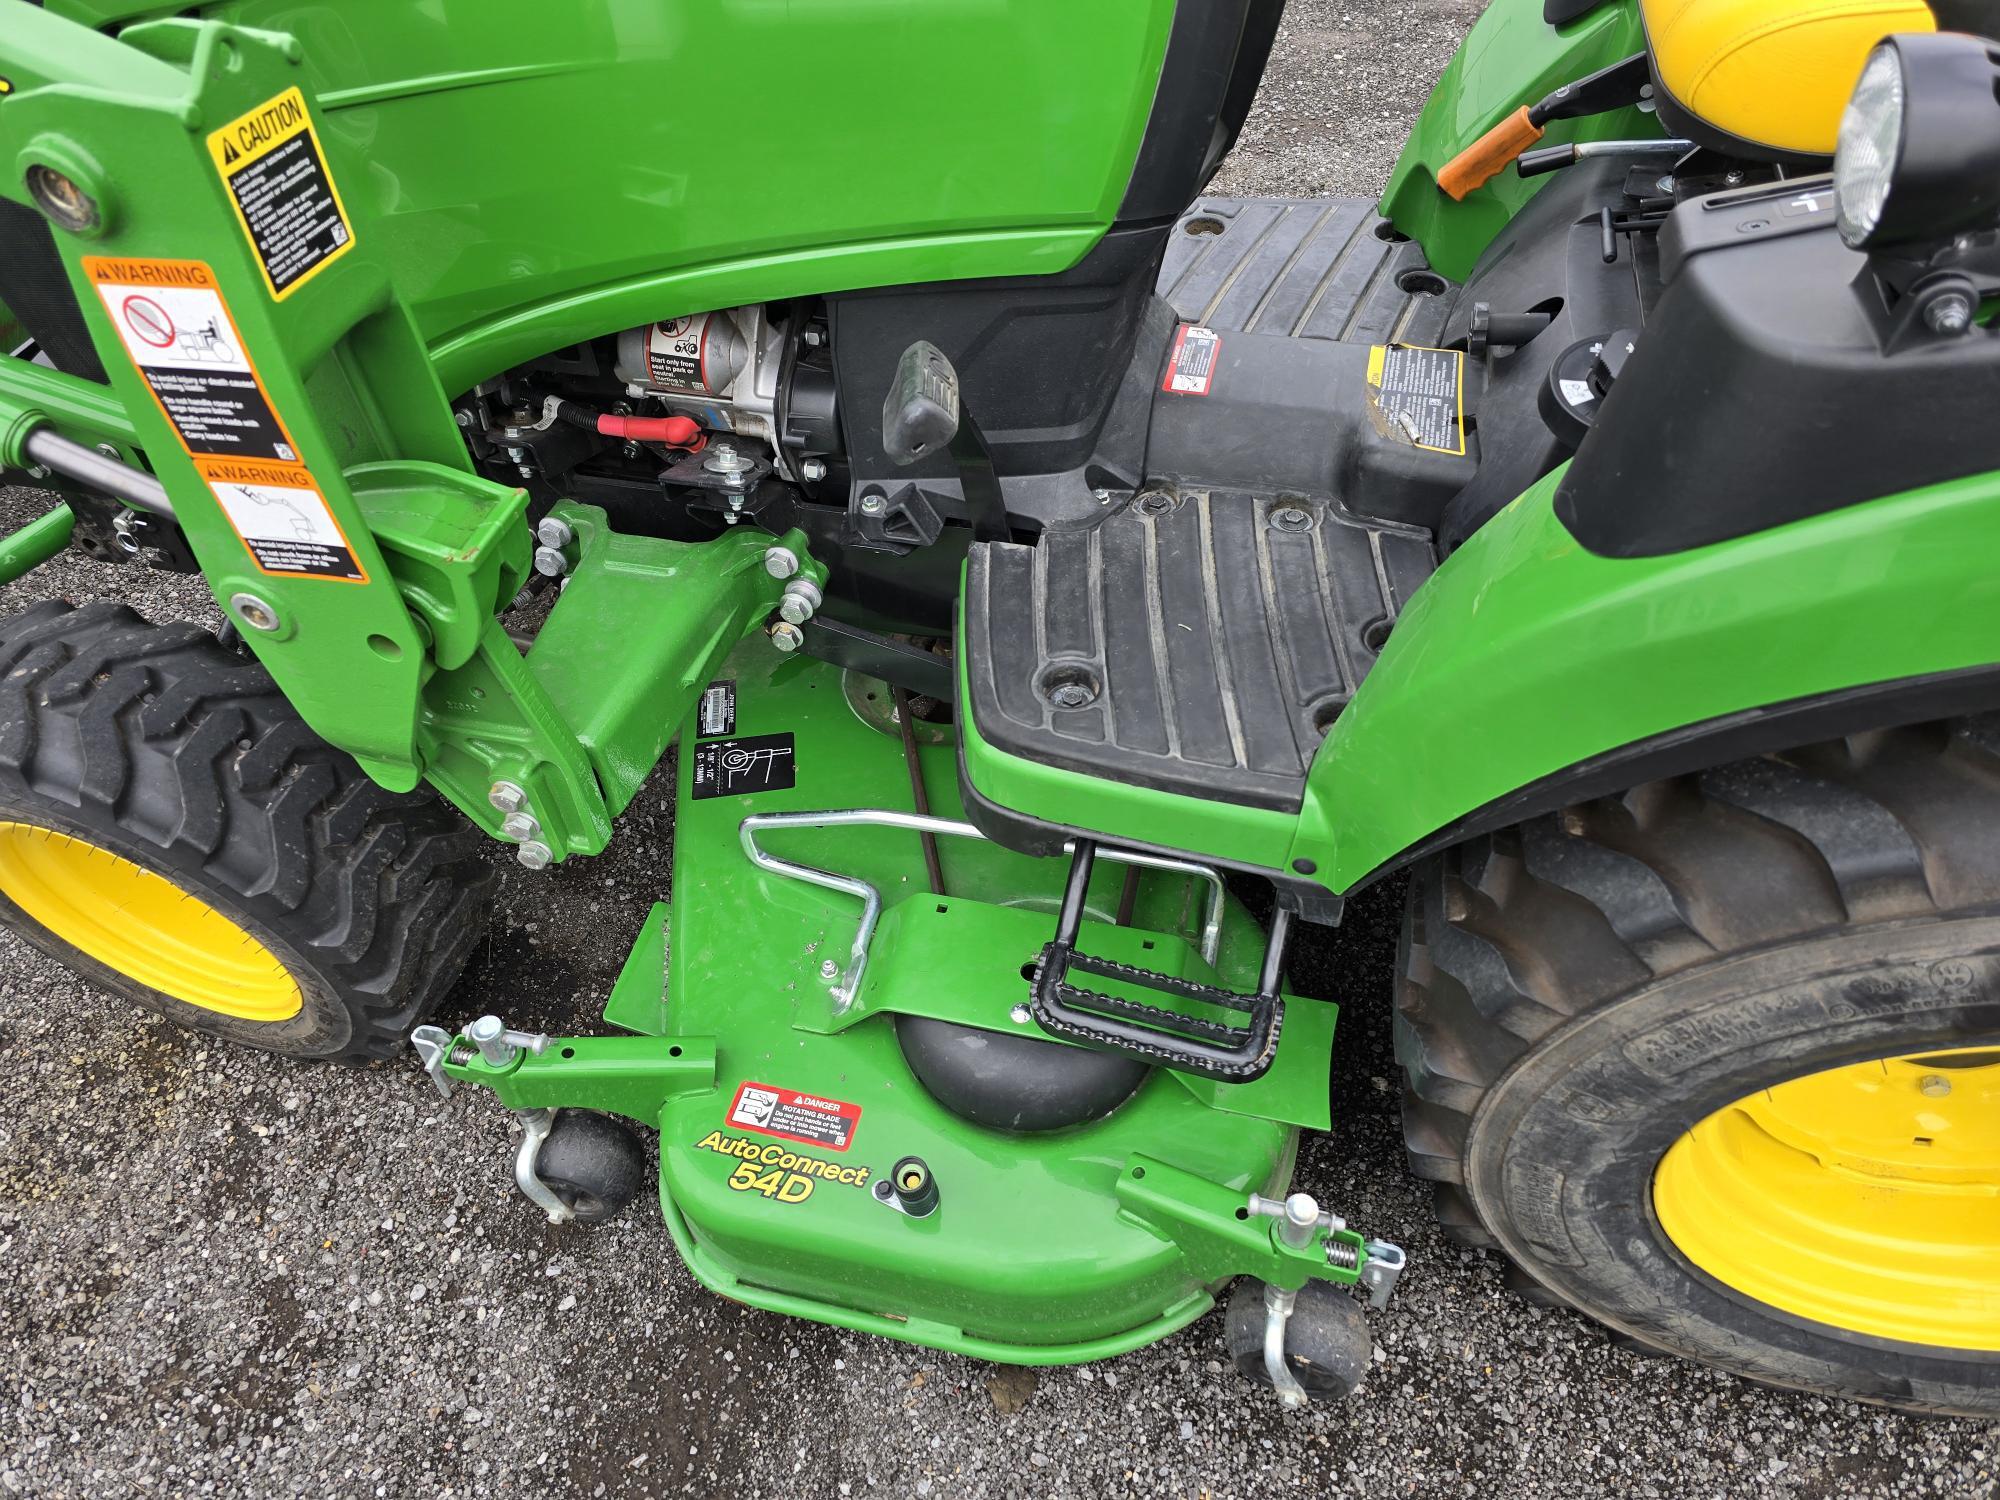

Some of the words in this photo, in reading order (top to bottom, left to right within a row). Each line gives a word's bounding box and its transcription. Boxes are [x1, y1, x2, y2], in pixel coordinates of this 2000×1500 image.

[238, 96, 303, 152] CAUTION
[107, 264, 208, 284] WARNING
[218, 465, 309, 485] WARNING
[782, 1105, 816, 1118] ROTATING
[817, 1113, 840, 1123] BLADE
[804, 1098, 840, 1112] DANGER
[770, 1122, 790, 1130] engine
[796, 1128, 818, 1138] running
[804, 1117, 822, 1125] hands
[809, 1125, 828, 1133] mower
[695, 1130, 872, 1188] AutoConnect
[728, 1162, 816, 1204] 54D
